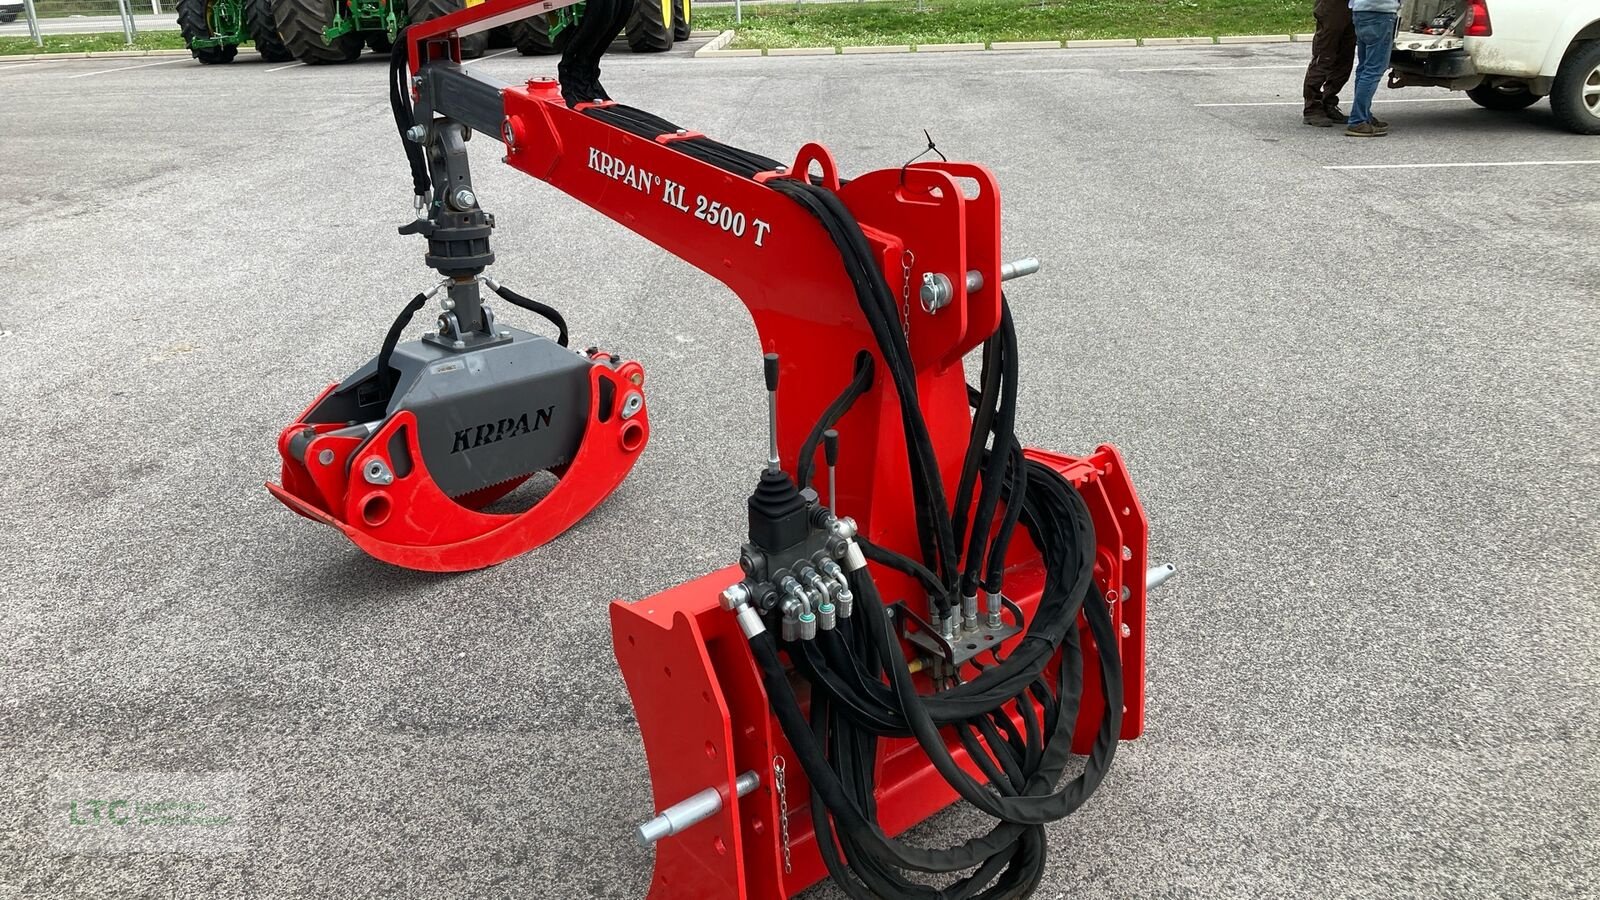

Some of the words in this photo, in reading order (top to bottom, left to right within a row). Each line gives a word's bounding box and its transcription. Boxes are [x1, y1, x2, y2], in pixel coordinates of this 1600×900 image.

[662, 178, 690, 213] KL
[694, 195, 747, 238] 2500
[752, 218, 771, 247] T
[450, 405, 556, 455] KRPAN
